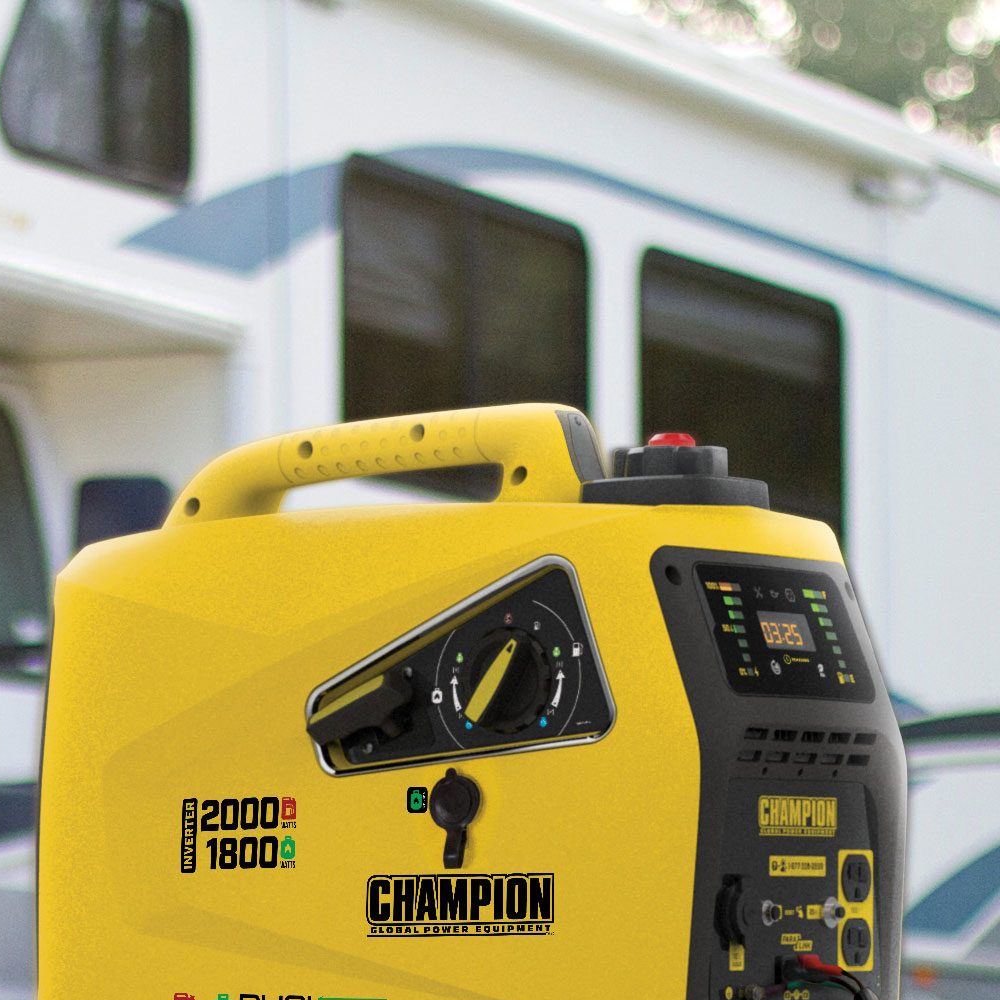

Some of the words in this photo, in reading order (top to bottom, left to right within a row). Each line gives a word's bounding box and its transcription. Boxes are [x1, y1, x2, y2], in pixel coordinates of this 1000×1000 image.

[760, 621, 804, 646] 03:25
[201, 797, 279, 831] 2000
[760, 798, 836, 827] CHAMPION
[183, 801, 195, 870] INVERTER
[206, 836, 279, 869] 1800
[369, 878, 552, 922] CHAMPION
[370, 926, 420, 934] GLOBAL
[423, 926, 469, 934] POWER
[475, 924, 551, 933] EQUIPMENT
